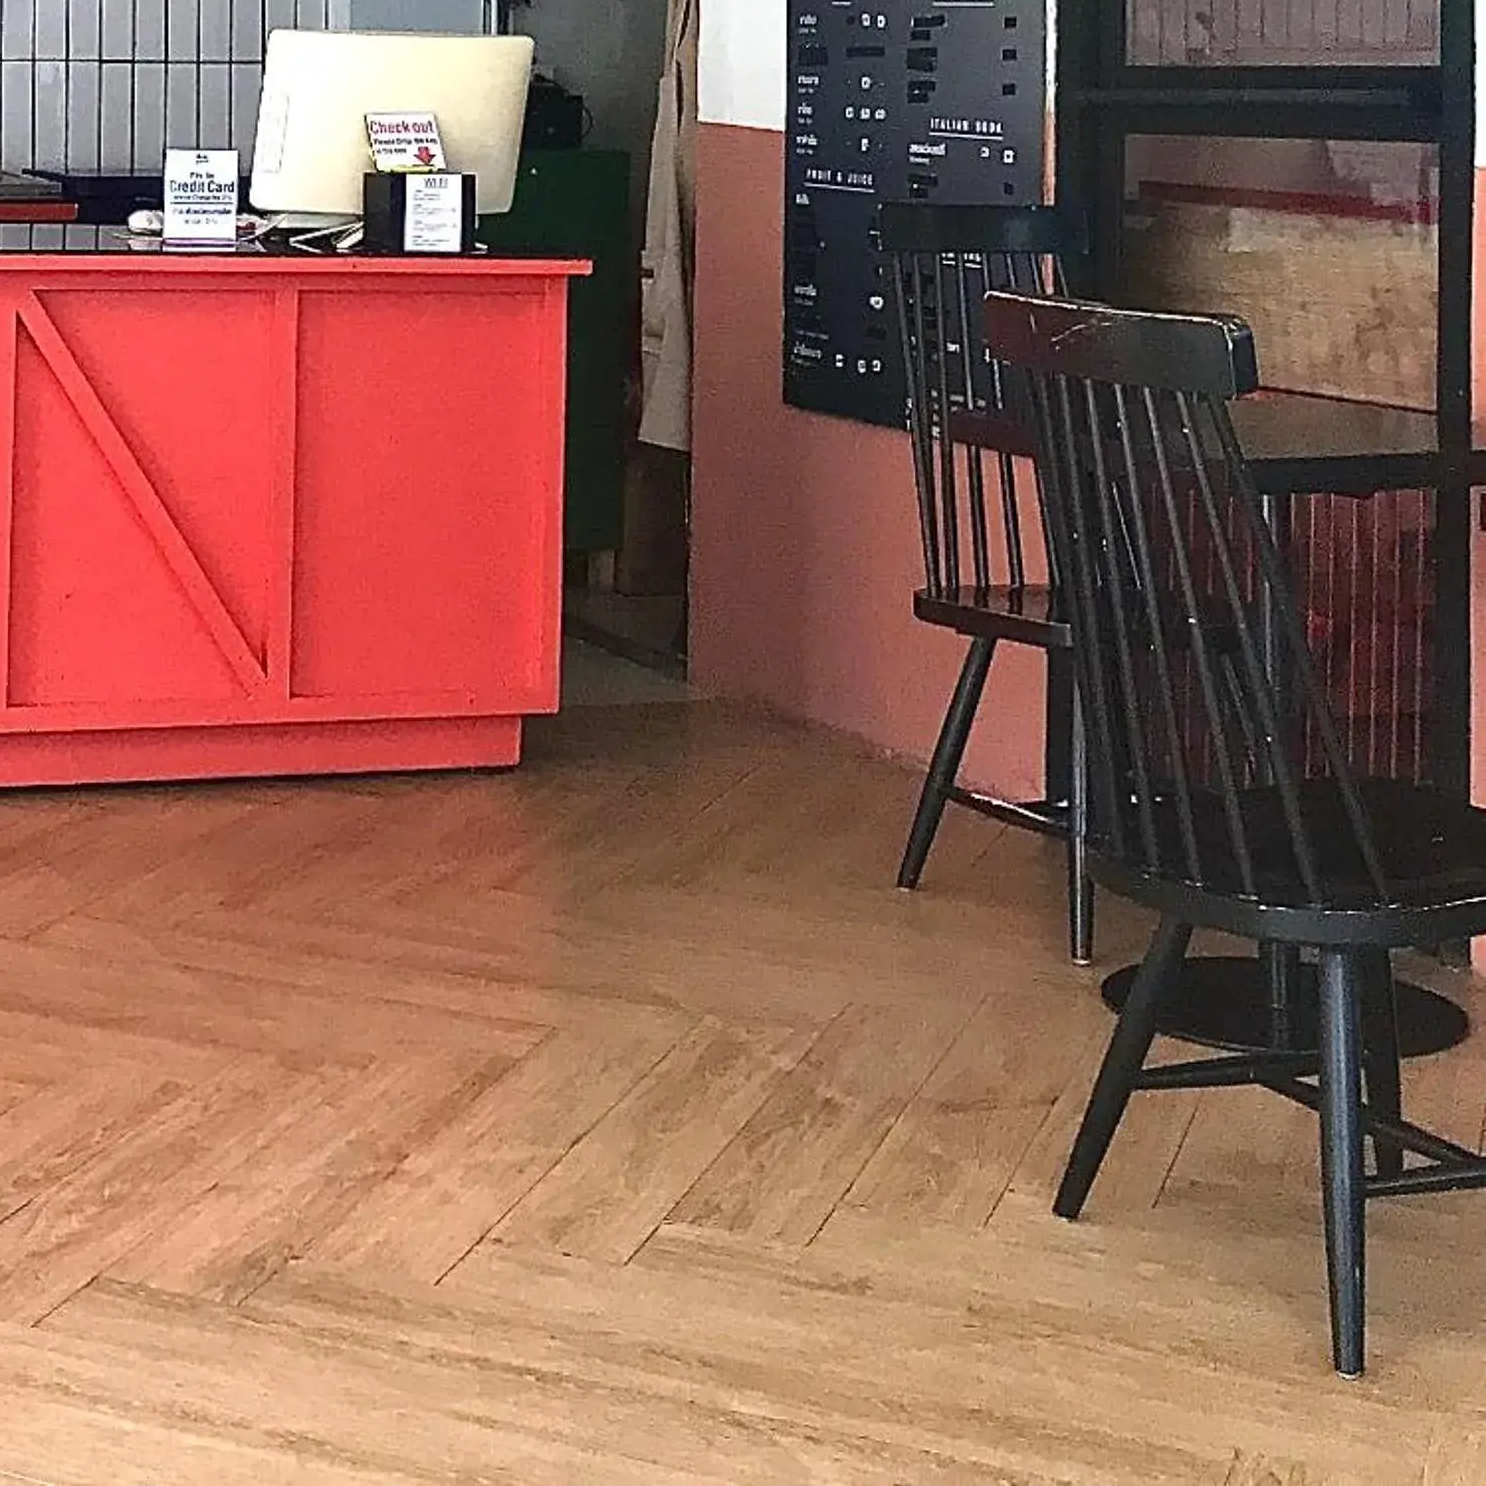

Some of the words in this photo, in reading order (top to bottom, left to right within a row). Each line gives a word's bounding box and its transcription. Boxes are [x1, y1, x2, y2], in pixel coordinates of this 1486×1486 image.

[370, 120, 411, 133] Check
[412, 120, 434, 133] out
[930, 117, 969, 131] ITALIAN
[806, 168, 832, 181] FRUIT
[169, 180, 205, 193] Credit
[207, 180, 234, 193] Card
